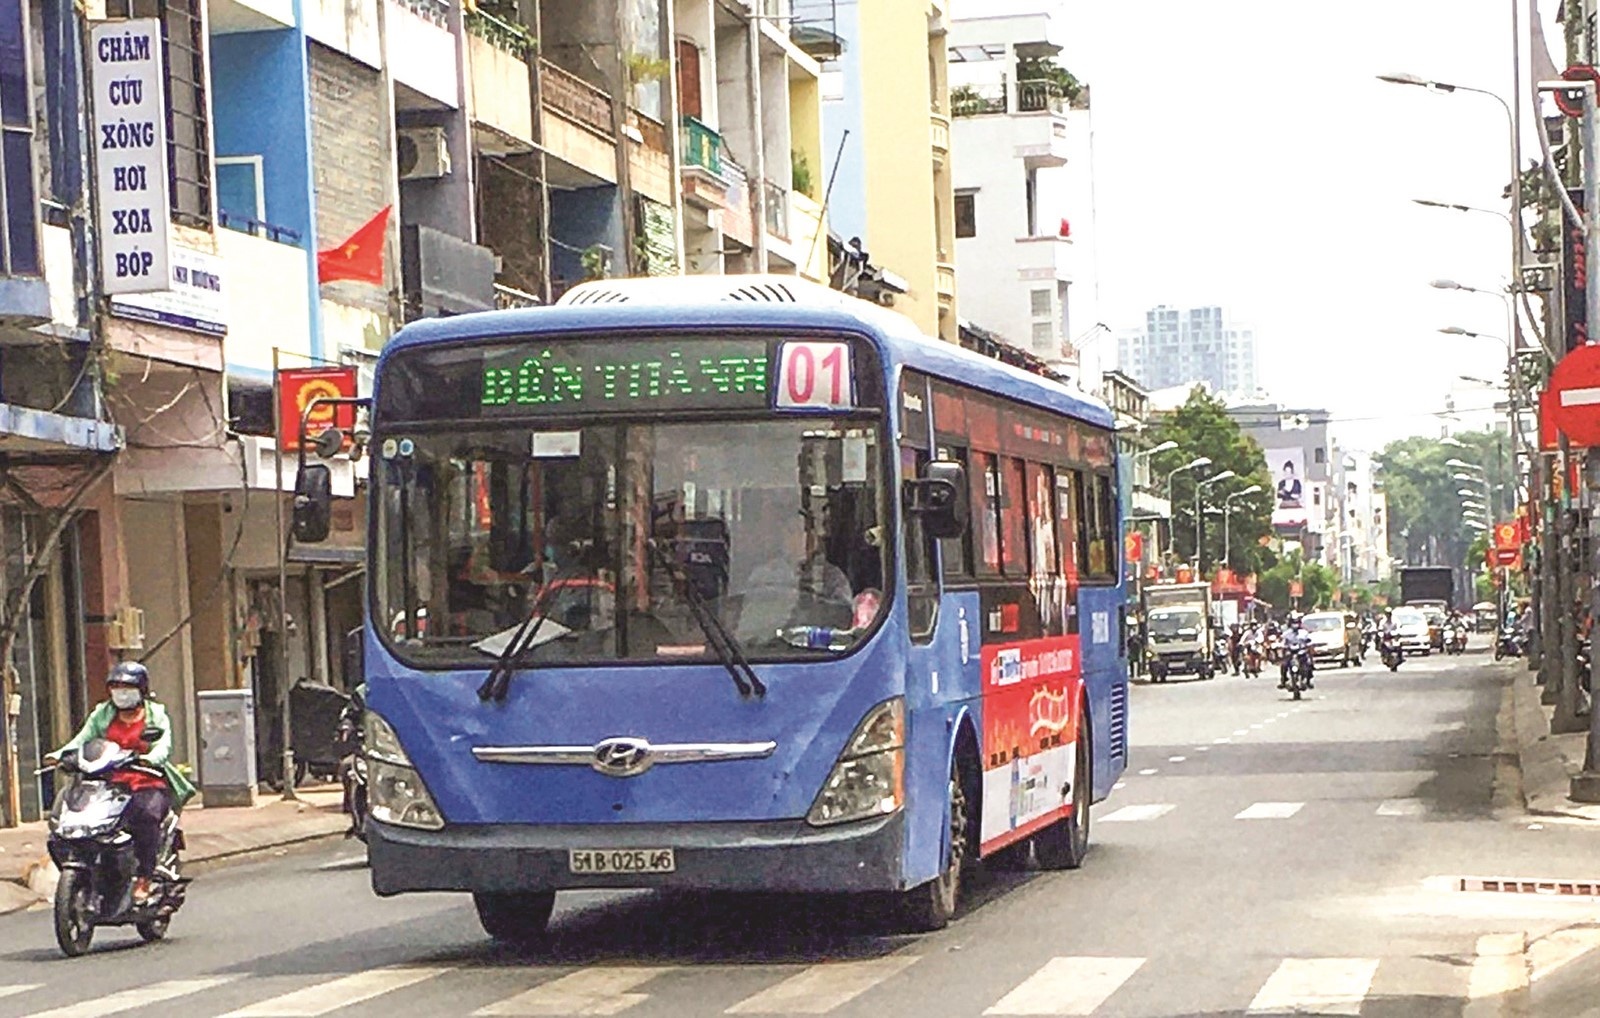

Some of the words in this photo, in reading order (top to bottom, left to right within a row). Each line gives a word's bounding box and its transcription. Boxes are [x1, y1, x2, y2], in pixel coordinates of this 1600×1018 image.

[98, 31, 150, 62] CHÂM
[109, 75, 142, 105] CỨU
[101, 117, 153, 149] XÔNG
[112, 208, 152, 234] XOA
[115, 245, 153, 277] BÓP
[787, 345, 842, 404] 01
